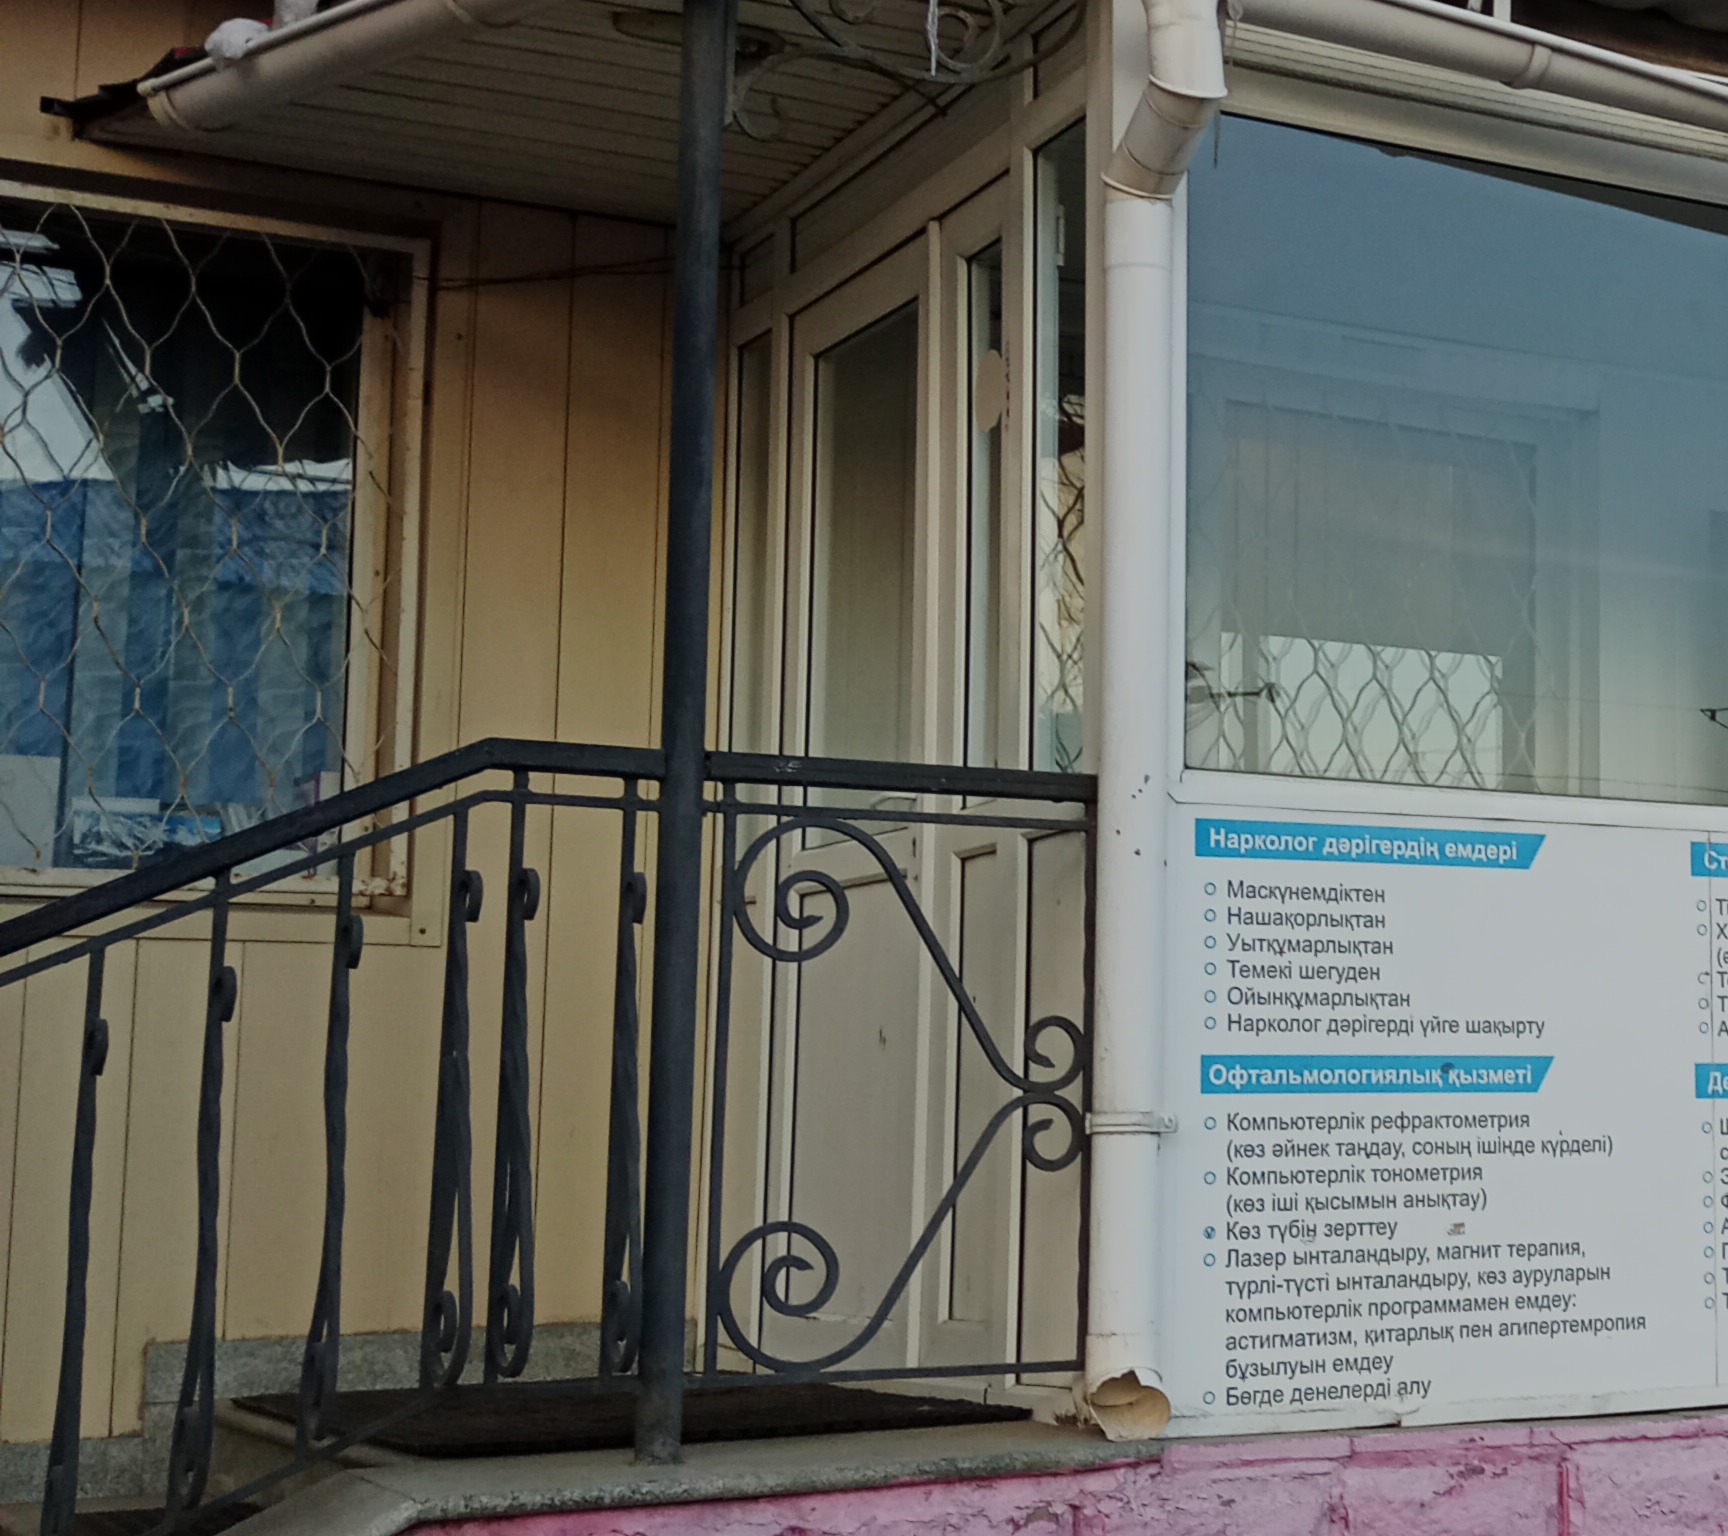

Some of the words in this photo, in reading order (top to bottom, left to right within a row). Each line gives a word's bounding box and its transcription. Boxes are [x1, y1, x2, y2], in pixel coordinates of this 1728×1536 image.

[1210, 827, 1317, 853] Нарколог
[1322, 834, 1439, 860] дәрігердің
[1444, 841, 1516, 864] емдері
[1227, 879, 1384, 904] Маскүнемдіктен
[1227, 906, 1385, 931] Нашақорлықтан
[1226, 932, 1393, 957] Уытқұмарлықтан
[1226, 959, 1291, 979] Темекі
[1299, 965, 1380, 984] шегуден
[1227, 986, 1410, 1010] Ойынқұмарлықтан
[1227, 1012, 1321, 1037] Нарколог
[1326, 1014, 1413, 1037] дәрігерді
[1419, 1015, 1459, 1038] үйге
[1465, 1019, 1544, 1038] шақырту
[1209, 1063, 1443, 1089] Офтальмологиялық
[1447, 1064, 1531, 1087] қызметі
[1227, 1111, 1364, 1134] Компьютерлік
[1371, 1110, 1529, 1134] рефрактометрия
[1226, 1139, 1265, 1162] (көз
[1272, 1138, 1330, 1157] әйнек
[1335, 1141, 1405, 1160] таңдау,
[1412, 1140, 1471, 1157] соның
[1541, 1139, 1612, 1157] күрделі)
[1226, 1163, 1365, 1188] Компьютерлік
[1370, 1166, 1482, 1185] тонометрия
[1226, 1194, 1264, 1218] (көз
[1271, 1191, 1298, 1211] іші
[1305, 1194, 1396, 1214] қысымын
[1403, 1187, 1486, 1211] анықтау)
[1226, 1221, 1260, 1240] Көз
[1323, 1221, 1397, 1241] зерттеу
[1225, 1248, 1286, 1271] Лазер
[1293, 1246, 1429, 1264] ынталандыру,
[1436, 1244, 1501, 1260] магнит
[1506, 1241, 1585, 1261] терапия,
[1225, 1273, 1329, 1297] түрлі-түсті
[1336, 1271, 1470, 1291] ынталандыру,
[1477, 1270, 1506, 1284] көз
[1512, 1266, 1610, 1288] ауруларын
[1225, 1298, 1362, 1323] компьютерлік
[1368, 1296, 1508, 1320] программамен
[1225, 1330, 1357, 1350] астигматизм,
[1459, 1323, 1492, 1338] пен
[1225, 1358, 1325, 1382] бұзылуын
[1332, 1355, 1393, 1377] емдеу
[1226, 1386, 1284, 1408] Бөгде
[1289, 1378, 1390, 1405] денелерді
[1396, 1379, 1431, 1400] алу
